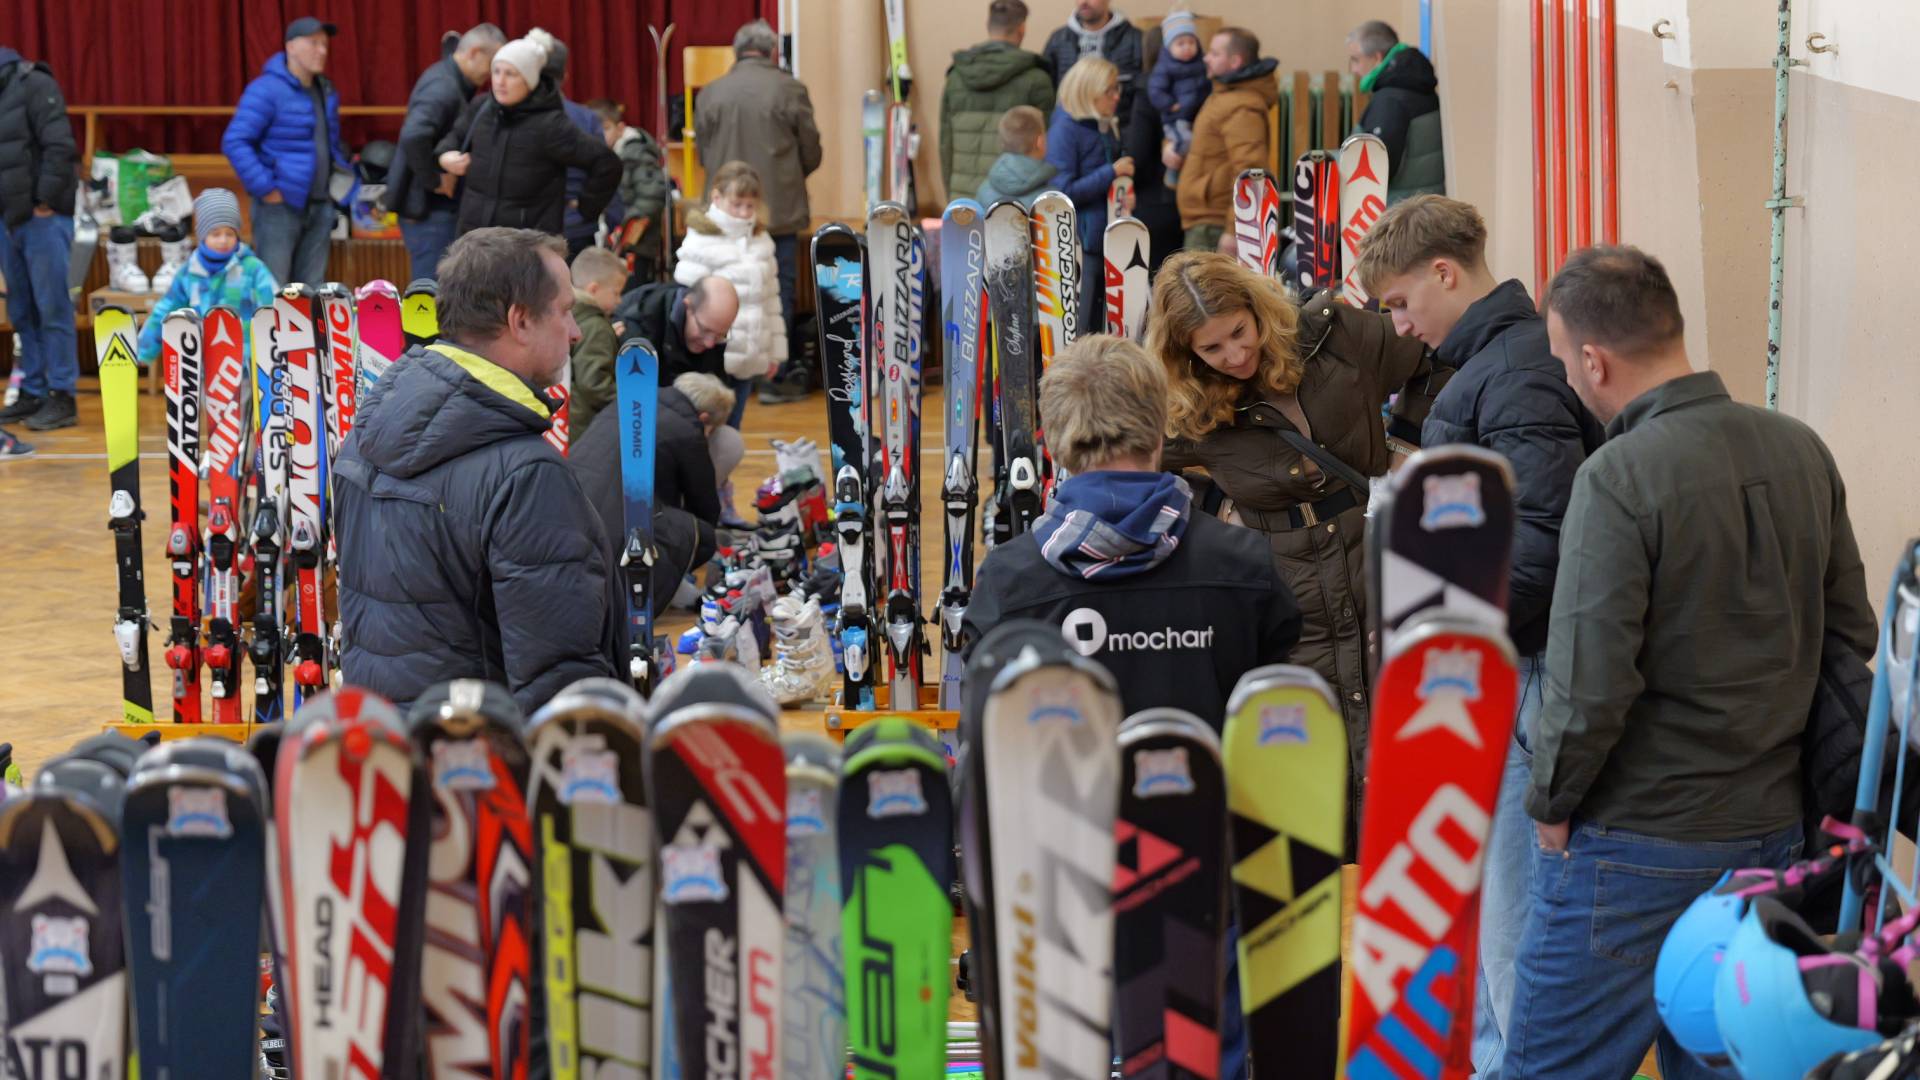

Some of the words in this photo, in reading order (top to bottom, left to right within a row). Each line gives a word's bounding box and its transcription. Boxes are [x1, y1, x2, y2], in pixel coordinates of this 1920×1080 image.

[1057, 210, 1077, 347] ROSSIGNOL
[180, 331, 198, 468] ATOMIC
[632, 400, 642, 459] ATOMIC
[1108, 625, 1214, 652] mochart
[314, 892, 336, 1030] HEAD
[1352, 782, 1492, 1016] ATO
[703, 927, 737, 1080] CHER
